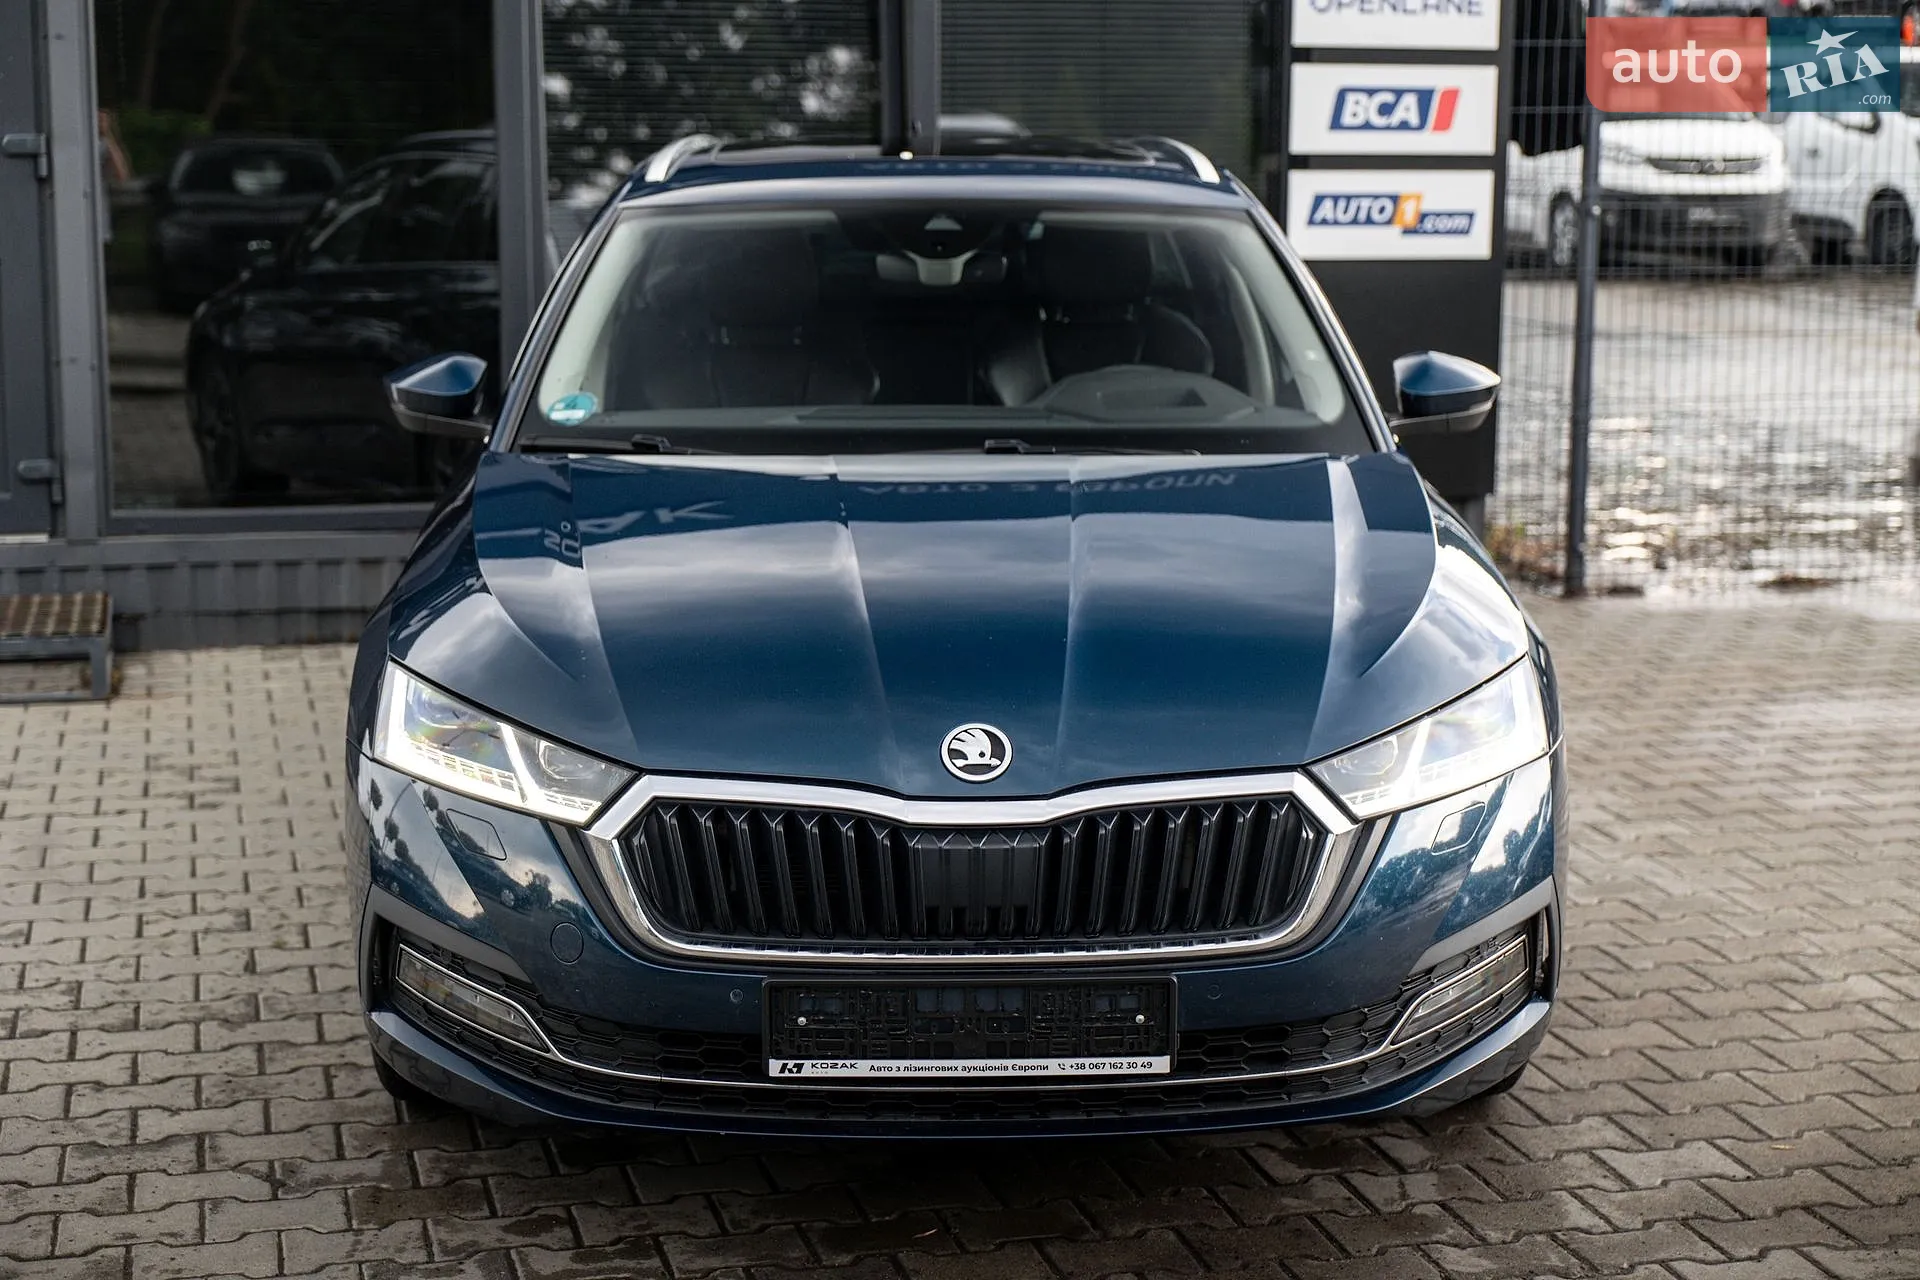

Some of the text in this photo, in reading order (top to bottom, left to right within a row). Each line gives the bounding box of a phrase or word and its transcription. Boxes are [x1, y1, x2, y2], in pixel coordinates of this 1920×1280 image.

[1340, 90, 1420, 128] BCA
[869, 1064, 893, 1072] Авто
[903, 1063, 959, 1072] лізингових
[961, 1063, 1009, 1074] аукціонів
[1011, 1063, 1049, 1073] Європи
[1069, 1061, 1153, 1070] +38 067 162 30 49
